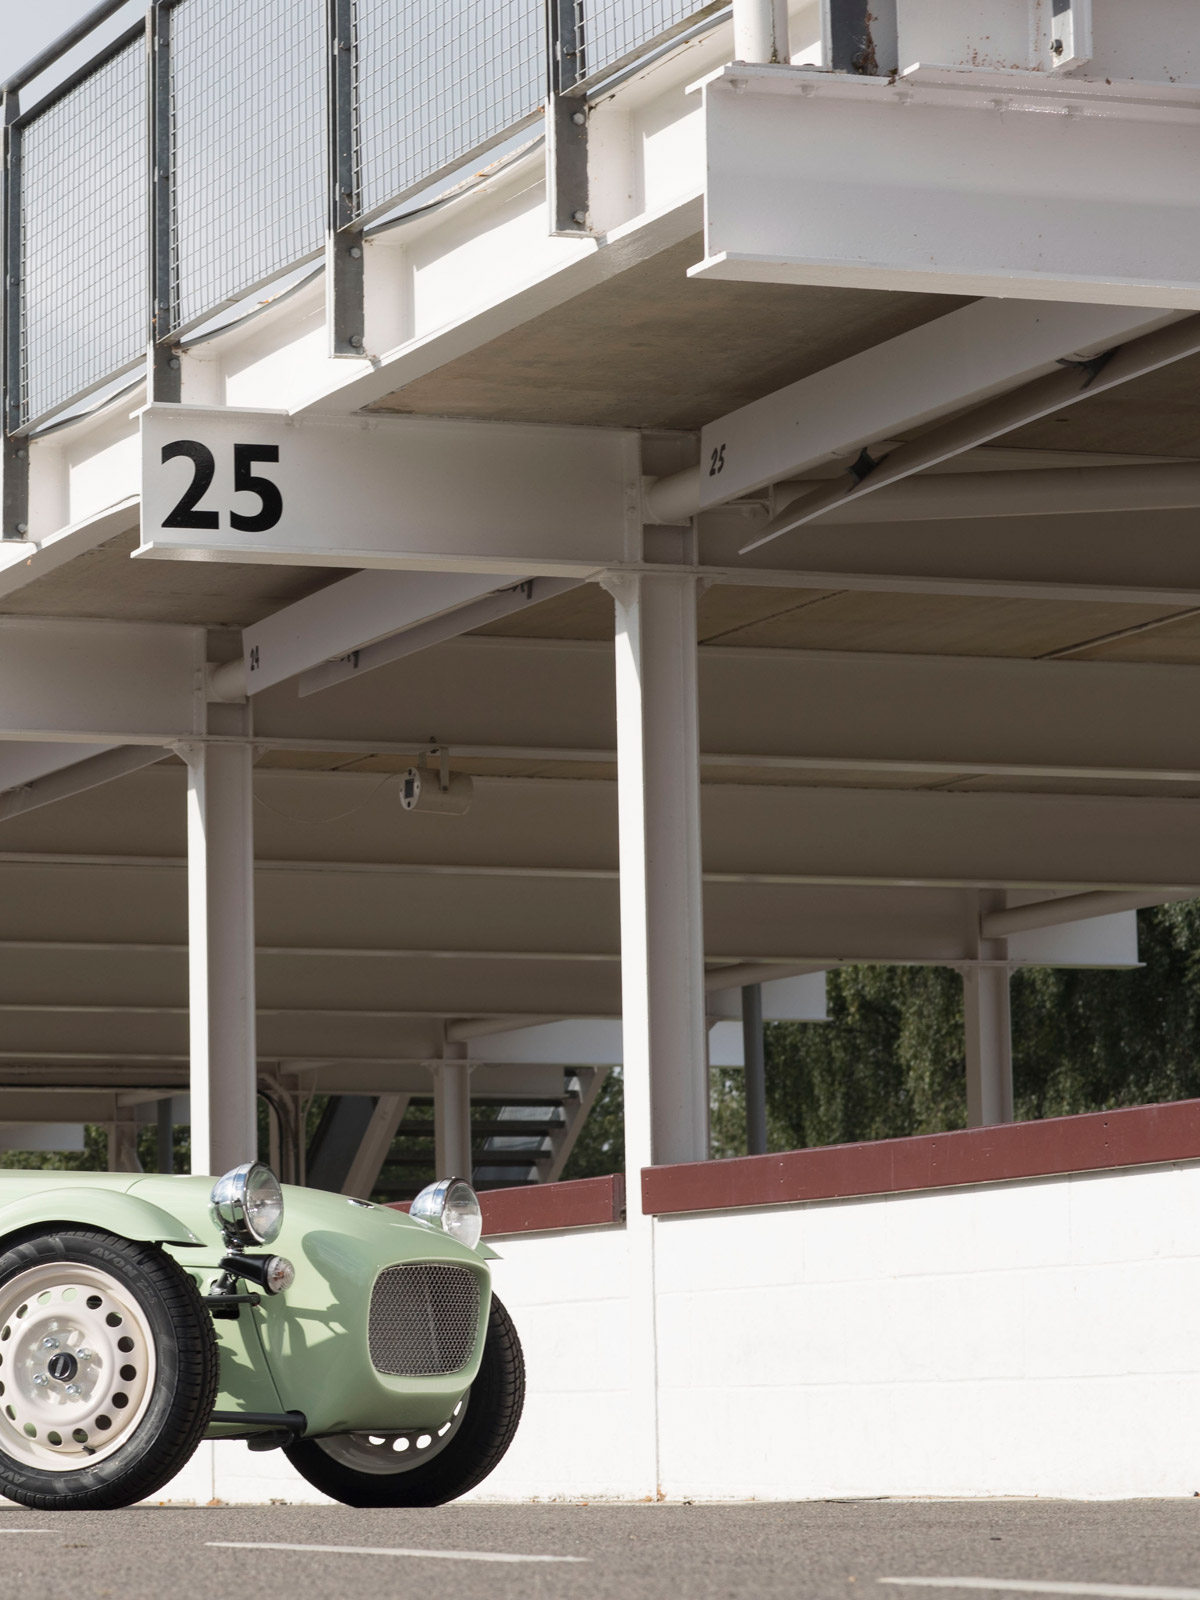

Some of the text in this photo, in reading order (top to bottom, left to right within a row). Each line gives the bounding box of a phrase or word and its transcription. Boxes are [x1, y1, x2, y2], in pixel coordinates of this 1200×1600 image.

[709, 443, 727, 477] 25
[161, 440, 284, 532] 25
[90, 1247, 138, 1278] AVON
